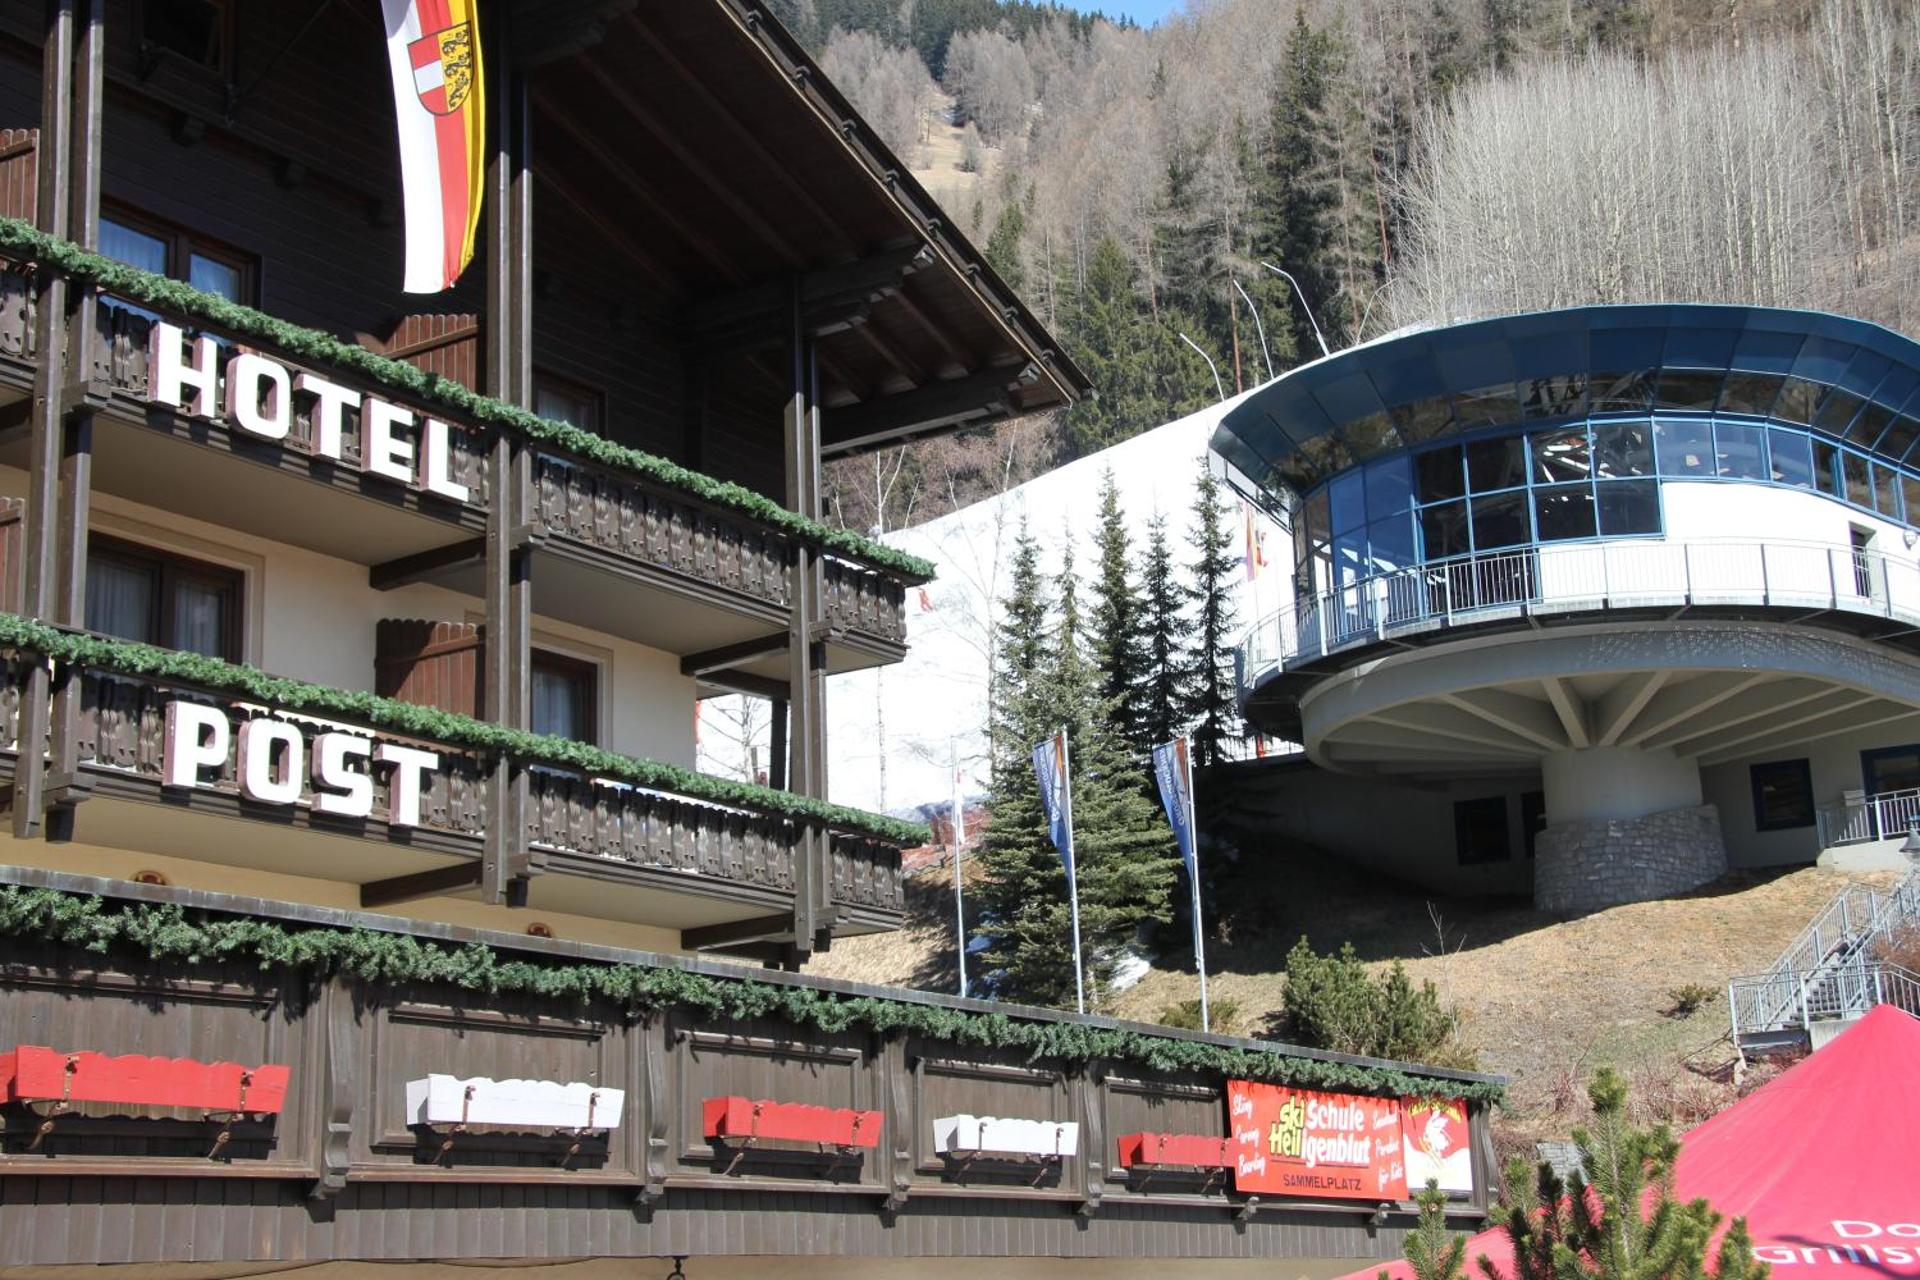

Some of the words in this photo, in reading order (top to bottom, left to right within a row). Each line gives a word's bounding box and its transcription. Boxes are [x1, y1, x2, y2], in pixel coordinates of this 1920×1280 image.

[150, 321, 469, 502] HOTEL
[163, 700, 439, 826] POST
[1268, 1122, 1371, 1168] Heiligenblut
[1283, 1173, 1362, 1191] SAMMELPLATZ
[1750, 1243, 1920, 1265] Grills
